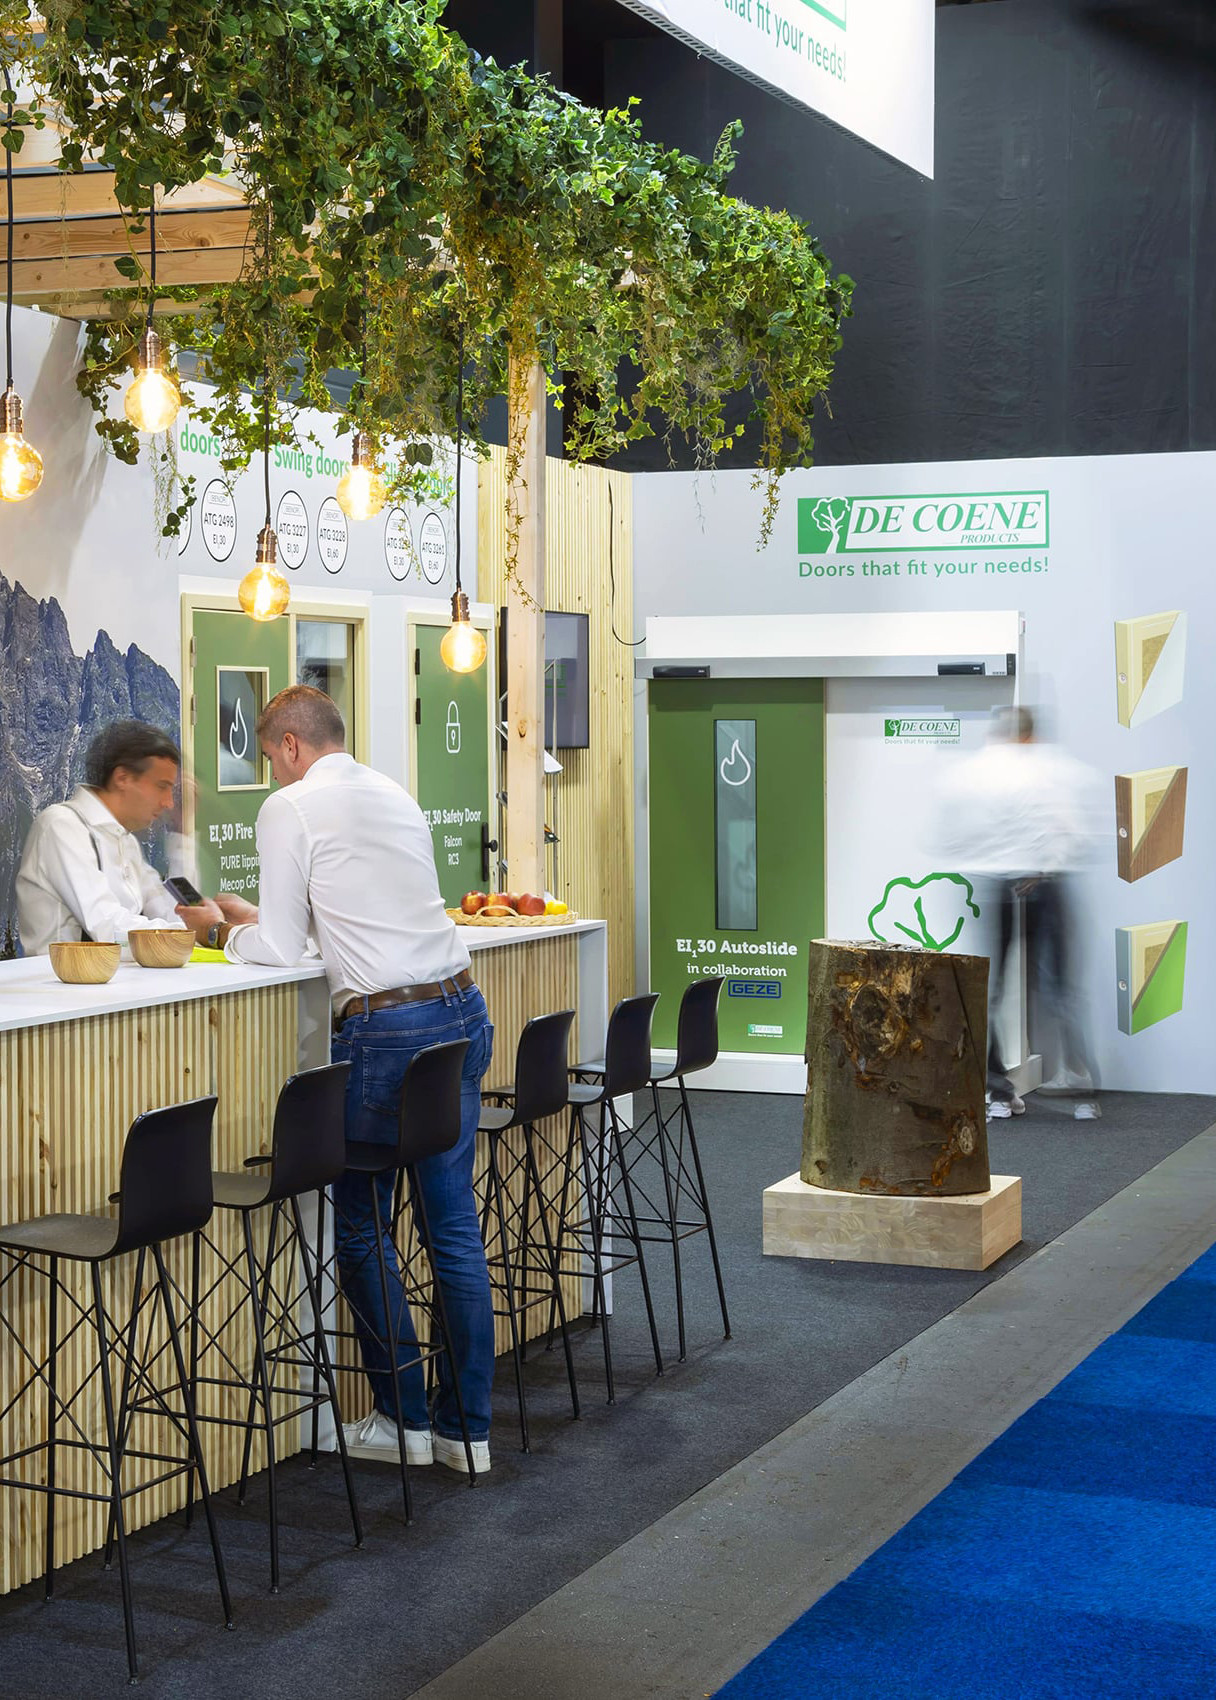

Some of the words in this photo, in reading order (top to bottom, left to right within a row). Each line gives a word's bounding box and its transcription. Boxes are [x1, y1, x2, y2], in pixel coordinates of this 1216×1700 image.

[724, 0, 752, 23] at
[774, 14, 804, 54] your
[807, 36, 846, 82] needs!
[180, 423, 221, 457] doors
[274, 441, 313, 479] Swing
[316, 450, 350, 478] doors
[204, 512, 218, 526] ATG
[218, 514, 235, 528] 2498
[851, 505, 906, 534] DE
[912, 501, 1042, 533] COENE
[279, 523, 291, 535] ATG
[292, 524, 307, 537] 3227
[319, 528, 331, 541] ATG
[959, 532, 1020, 544] PRODUCTS
[799, 561, 855, 577] Doors
[861, 560, 900, 576] that
[907, 558, 928, 575] fit
[934, 559, 978, 578] your
[984, 556, 1049, 574] needs!
[901, 722, 917, 732] DE
[919, 722, 958, 732] COENE
[442, 809, 464, 827] Safety
[464, 808, 482, 822] Door
[235, 822, 253, 840] Fire
[444, 835, 462, 848] Falcon
[220, 855, 241, 870] PURE
[242, 853, 260, 871] lippi
[448, 853, 459, 866] RC3
[220, 878, 245, 893] Mecop
[720, 940, 798, 956] Autoslide
[687, 962, 700, 974] in
[702, 963, 787, 977] collaboration
[732, 983, 777, 995] GEZE
